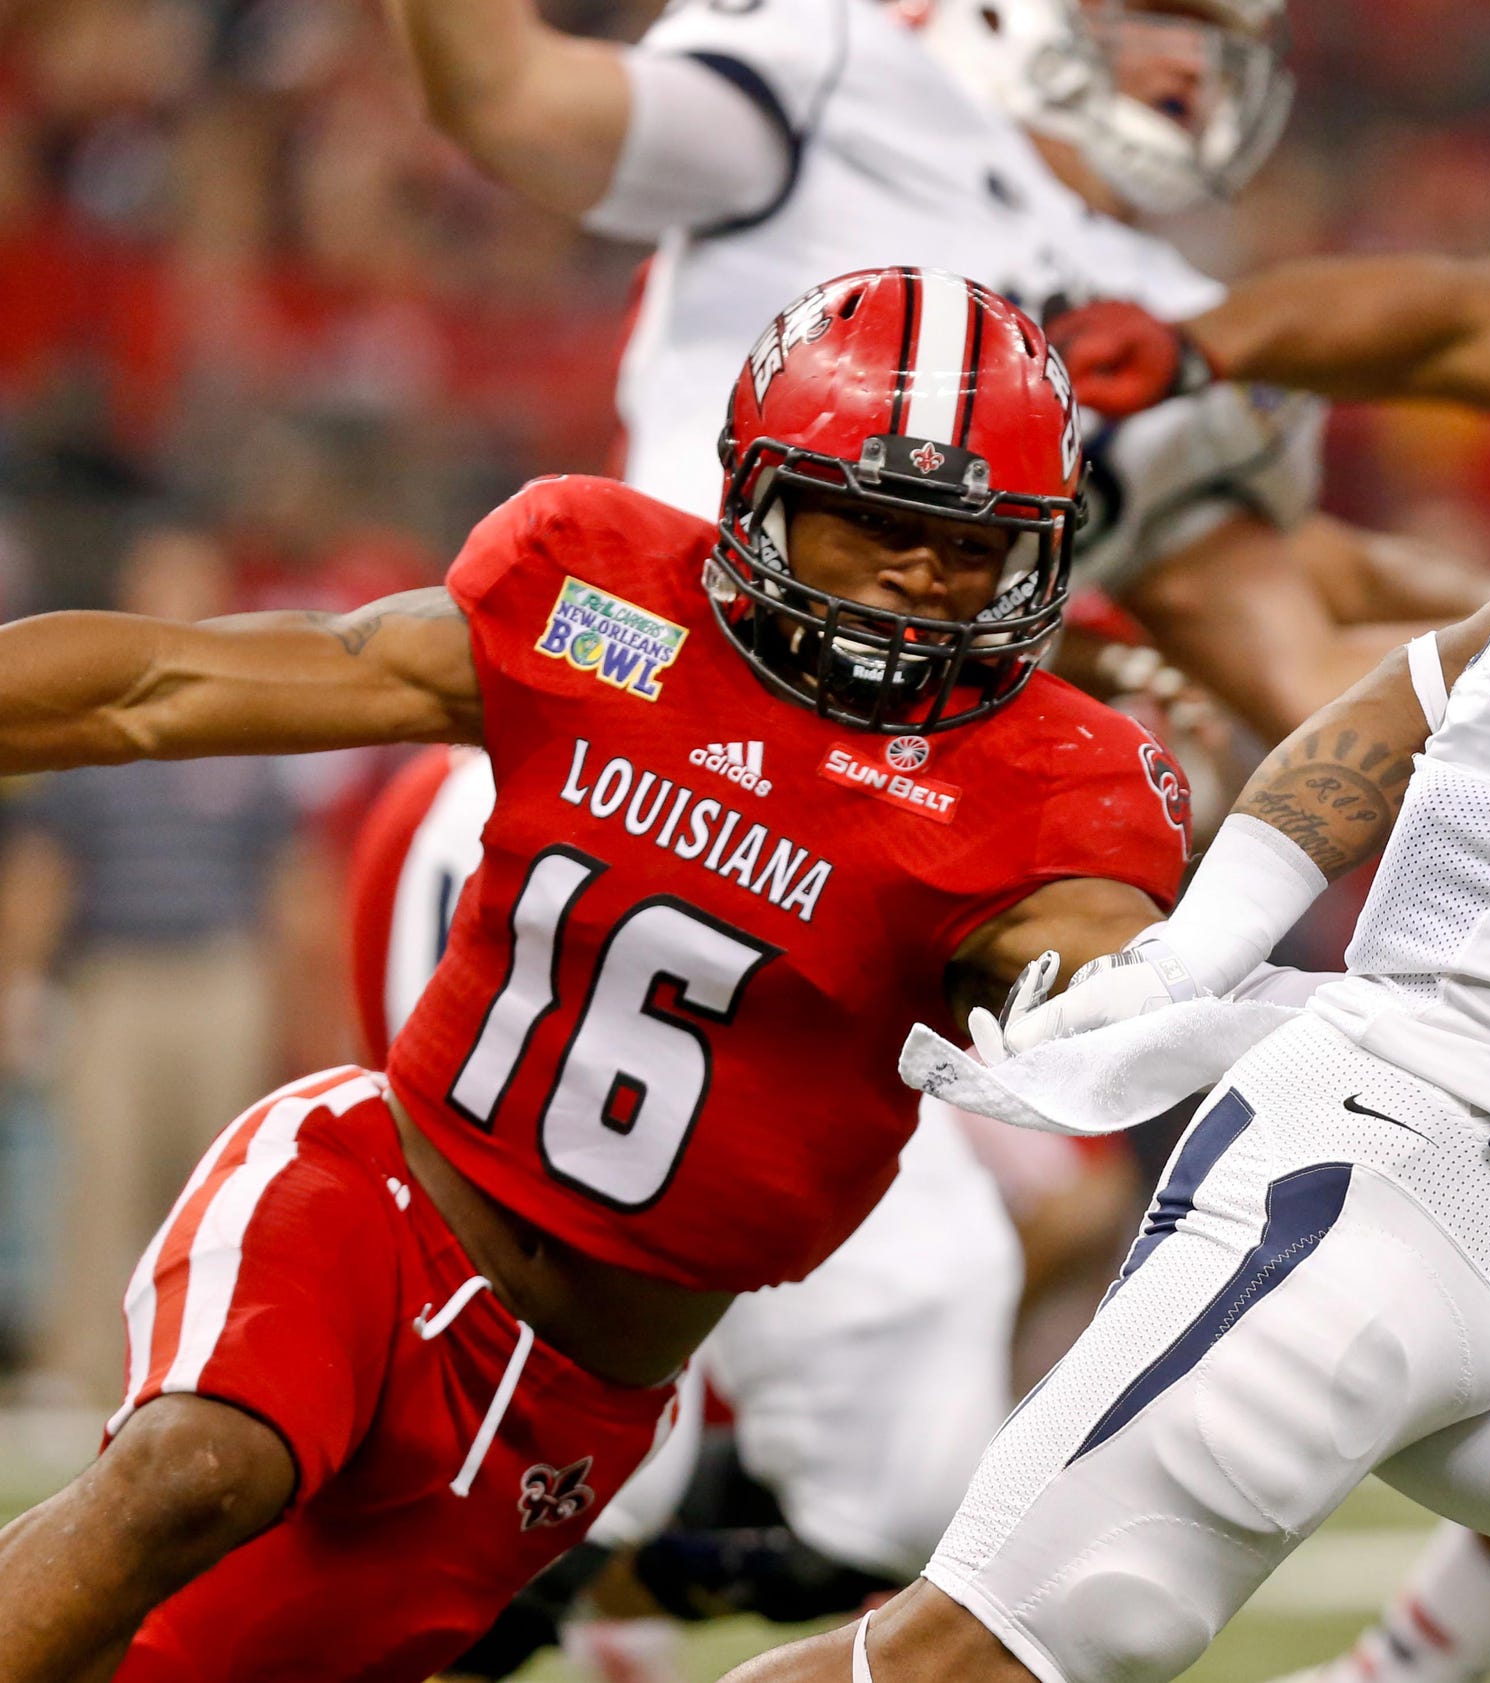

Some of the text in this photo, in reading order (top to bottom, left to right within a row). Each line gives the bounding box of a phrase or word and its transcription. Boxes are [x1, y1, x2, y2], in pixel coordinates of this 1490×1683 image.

[540, 618, 657, 696] BOWL
[556, 600, 674, 663] NEW ORLEANS
[688, 747, 773, 798] adidas
[825, 749, 956, 814] SUN BELT
[559, 737, 834, 923] LOUISIANA
[445, 841, 788, 1216] 16
